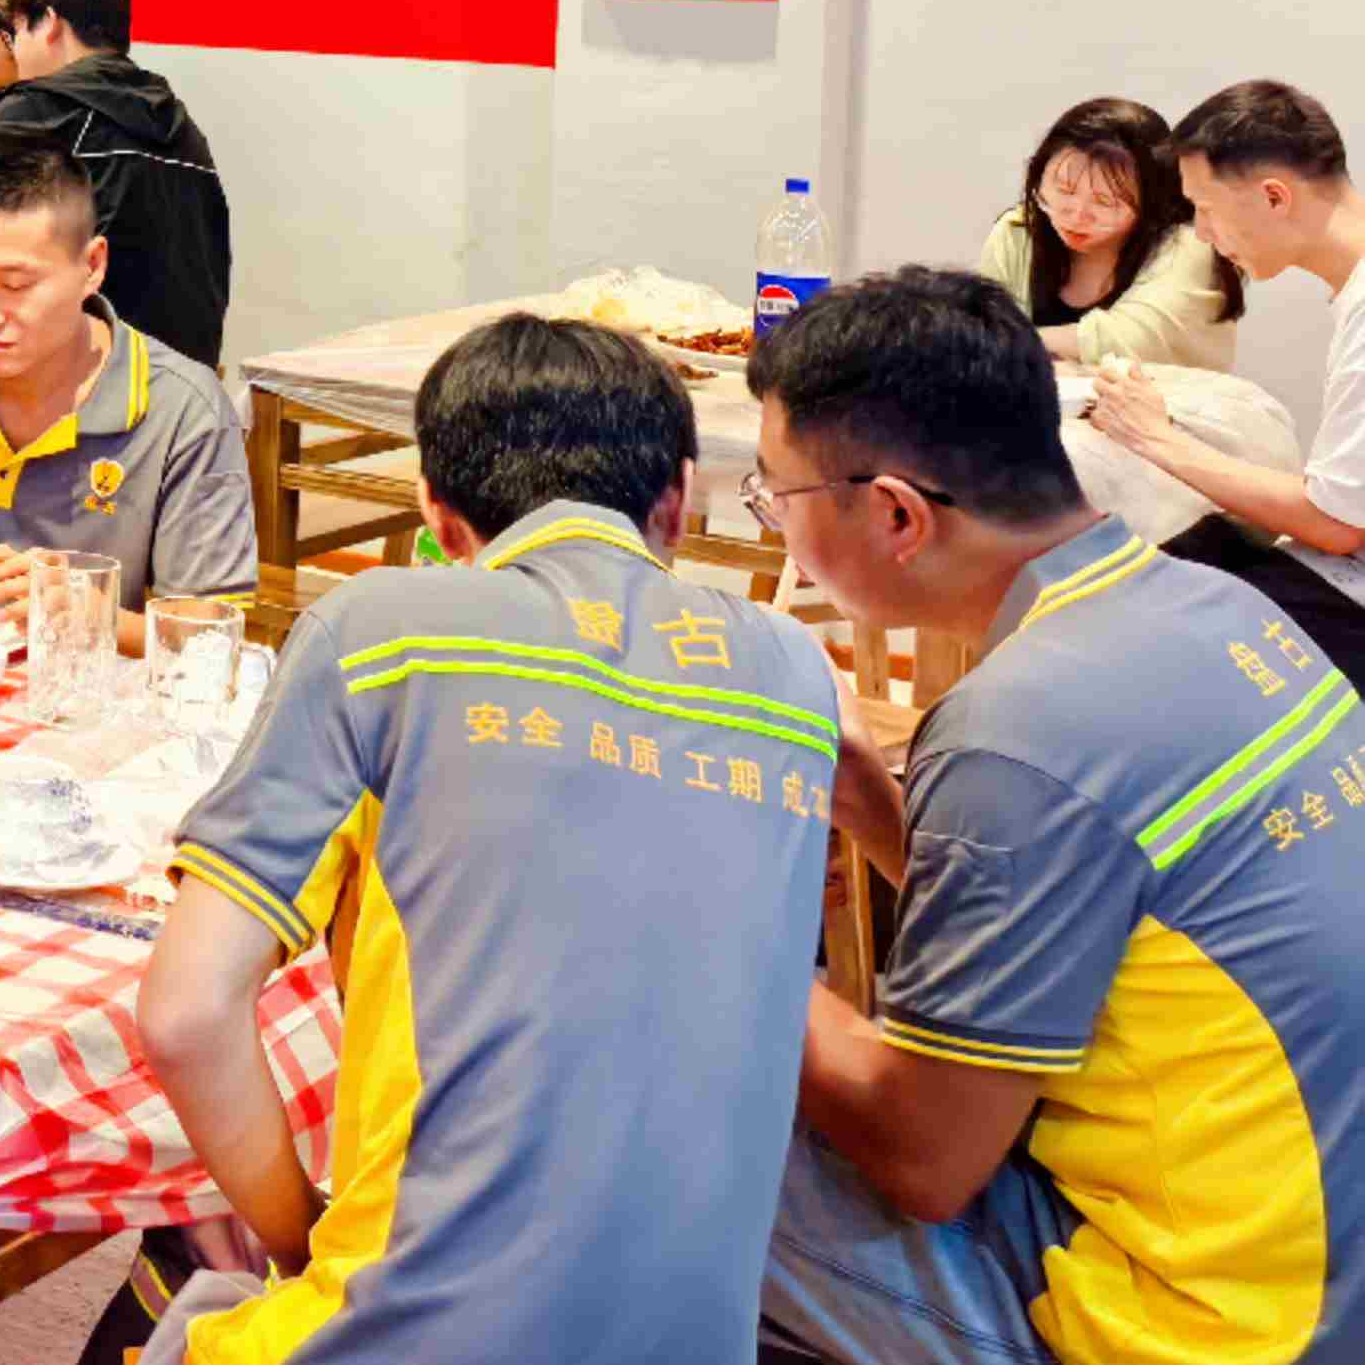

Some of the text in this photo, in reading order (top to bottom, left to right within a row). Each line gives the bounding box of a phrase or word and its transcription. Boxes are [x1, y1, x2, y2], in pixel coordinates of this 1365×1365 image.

[465, 701, 564, 749] 安全
[588, 721, 662, 780] 品质
[683, 750, 764, 804] 工期
[1262, 790, 1335, 852] 安全
